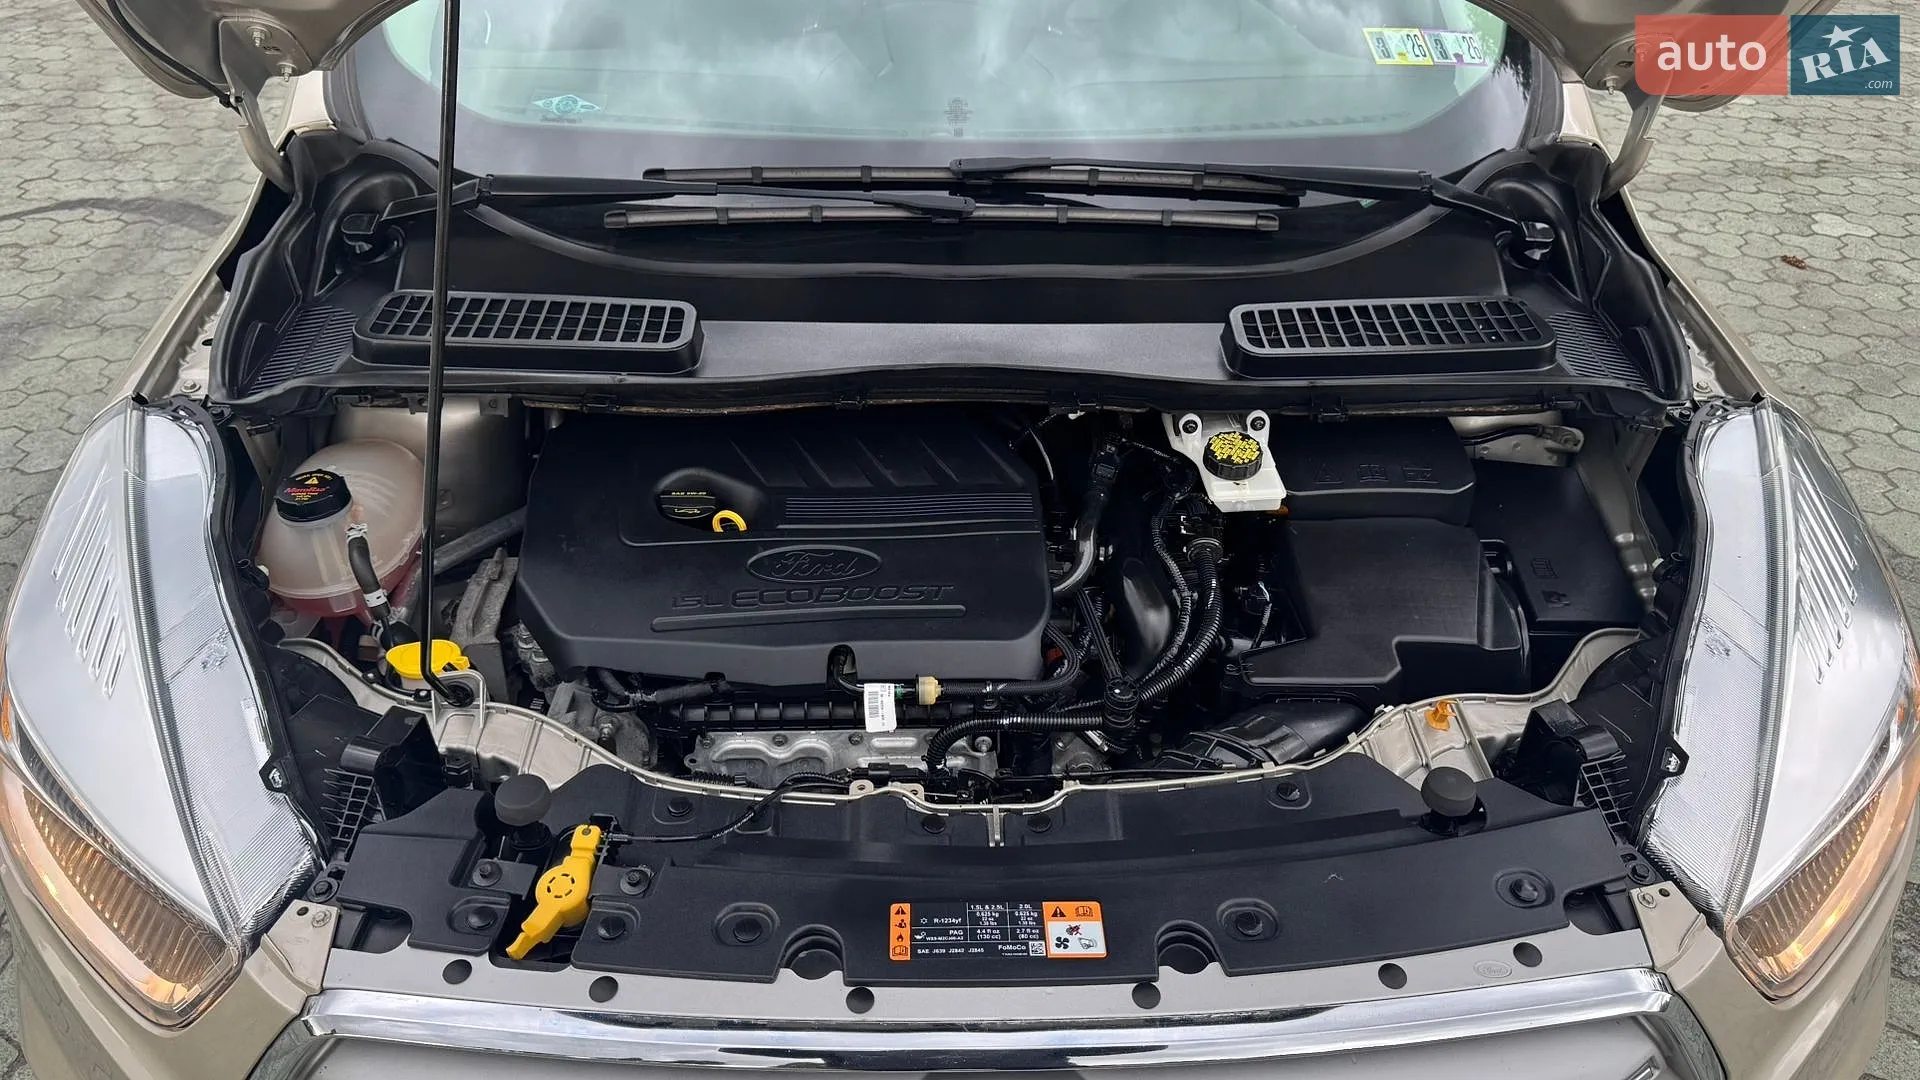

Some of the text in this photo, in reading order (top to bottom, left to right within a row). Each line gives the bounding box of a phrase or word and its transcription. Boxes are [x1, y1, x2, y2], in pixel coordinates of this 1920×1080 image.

[1406, 33, 1427, 58] 26
[1461, 35, 1482, 60] 26
[770, 551, 858, 577] Ford
[731, 585, 955, 609] ECOBOOST
